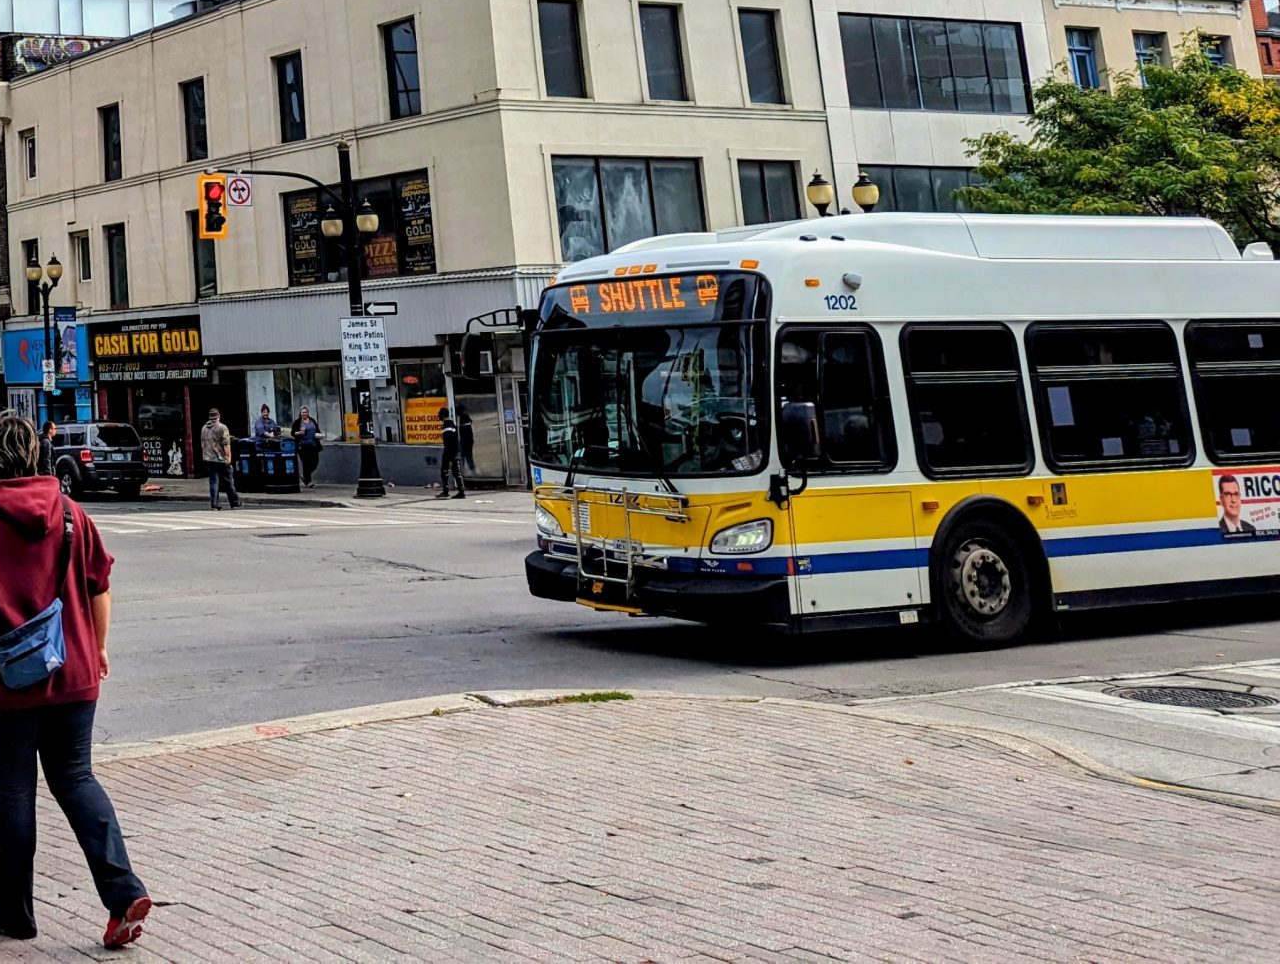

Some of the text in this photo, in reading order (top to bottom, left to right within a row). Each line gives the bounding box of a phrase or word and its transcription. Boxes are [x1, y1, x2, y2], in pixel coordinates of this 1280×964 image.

[406, 224, 432, 237] GOLD
[294, 239, 317, 251] GOLD
[599, 277, 686, 312] SHUTTLE
[824, 295, 858, 310] 1202
[347, 319, 377, 328] James St
[343, 330, 384, 339] Street Patios
[95, 330, 200, 356] CASH FOR GOLD
[349, 340, 380, 351] King St to
[344, 355, 357, 364] King
[358, 354, 379, 362] William
[123, 371, 134, 380] ONLY
[134, 371, 146, 380] MOST
[147, 370, 165, 380] TRUSTED
[166, 369, 192, 379] JEWELLERY
[192, 368, 208, 378] BUYER
[143, 441, 161, 449] OLD
